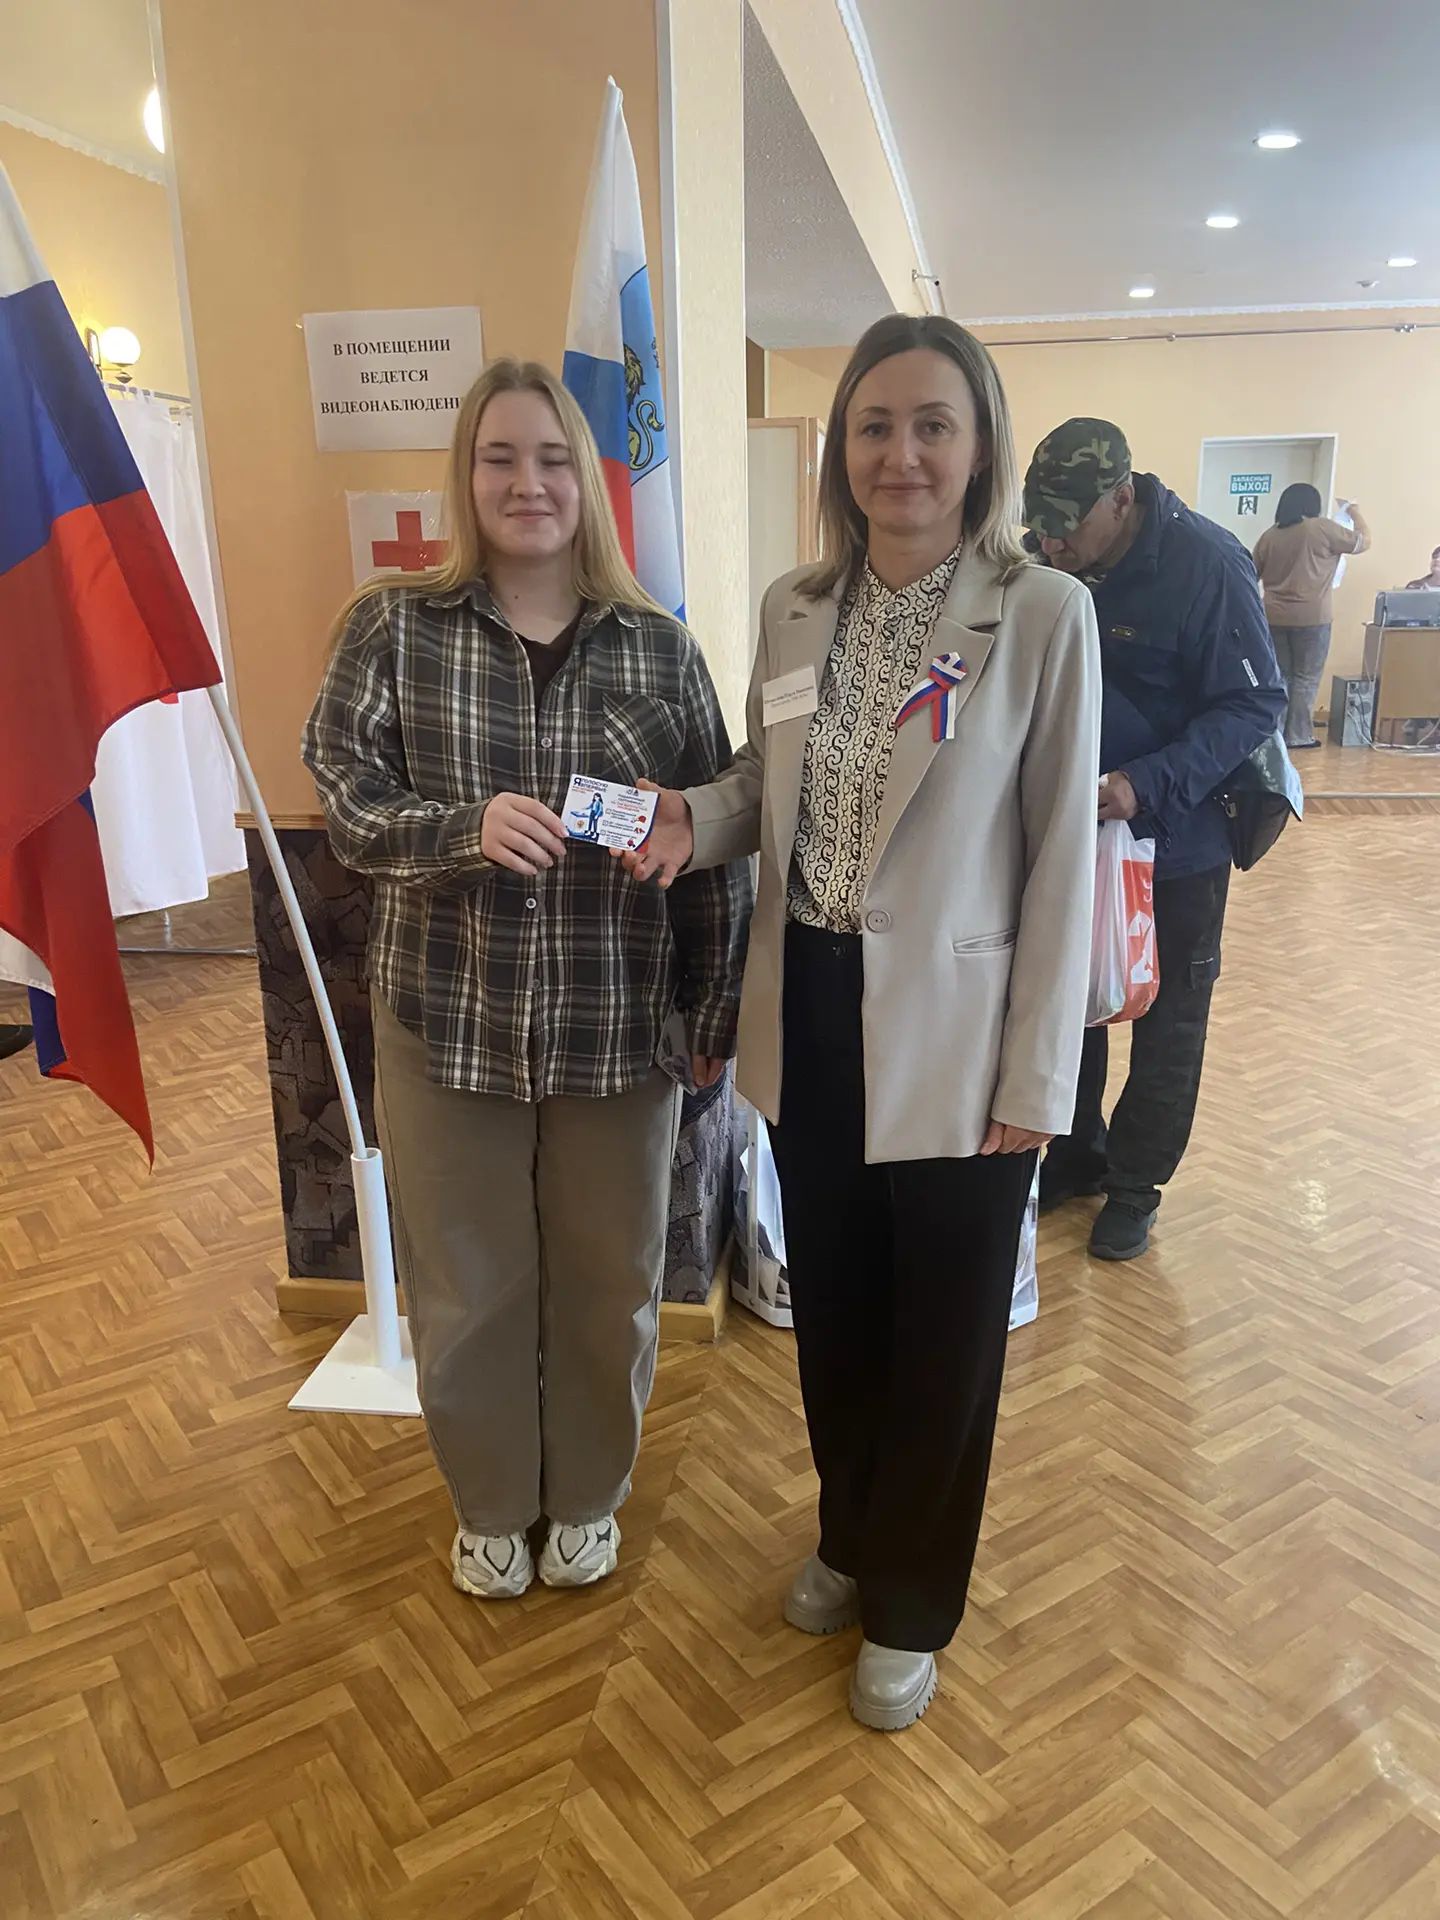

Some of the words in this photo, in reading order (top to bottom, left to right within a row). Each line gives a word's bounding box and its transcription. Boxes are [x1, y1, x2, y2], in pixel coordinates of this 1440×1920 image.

[333, 344, 342, 356] В
[347, 339, 450, 355] ПОМЕЩЕНИИ
[361, 369, 429, 384] ВЕДЕТСЯ
[321, 397, 460, 415] ВИДЕОНАБЛЮДЕН
[1231, 482, 1269, 492] ВЫХОД
